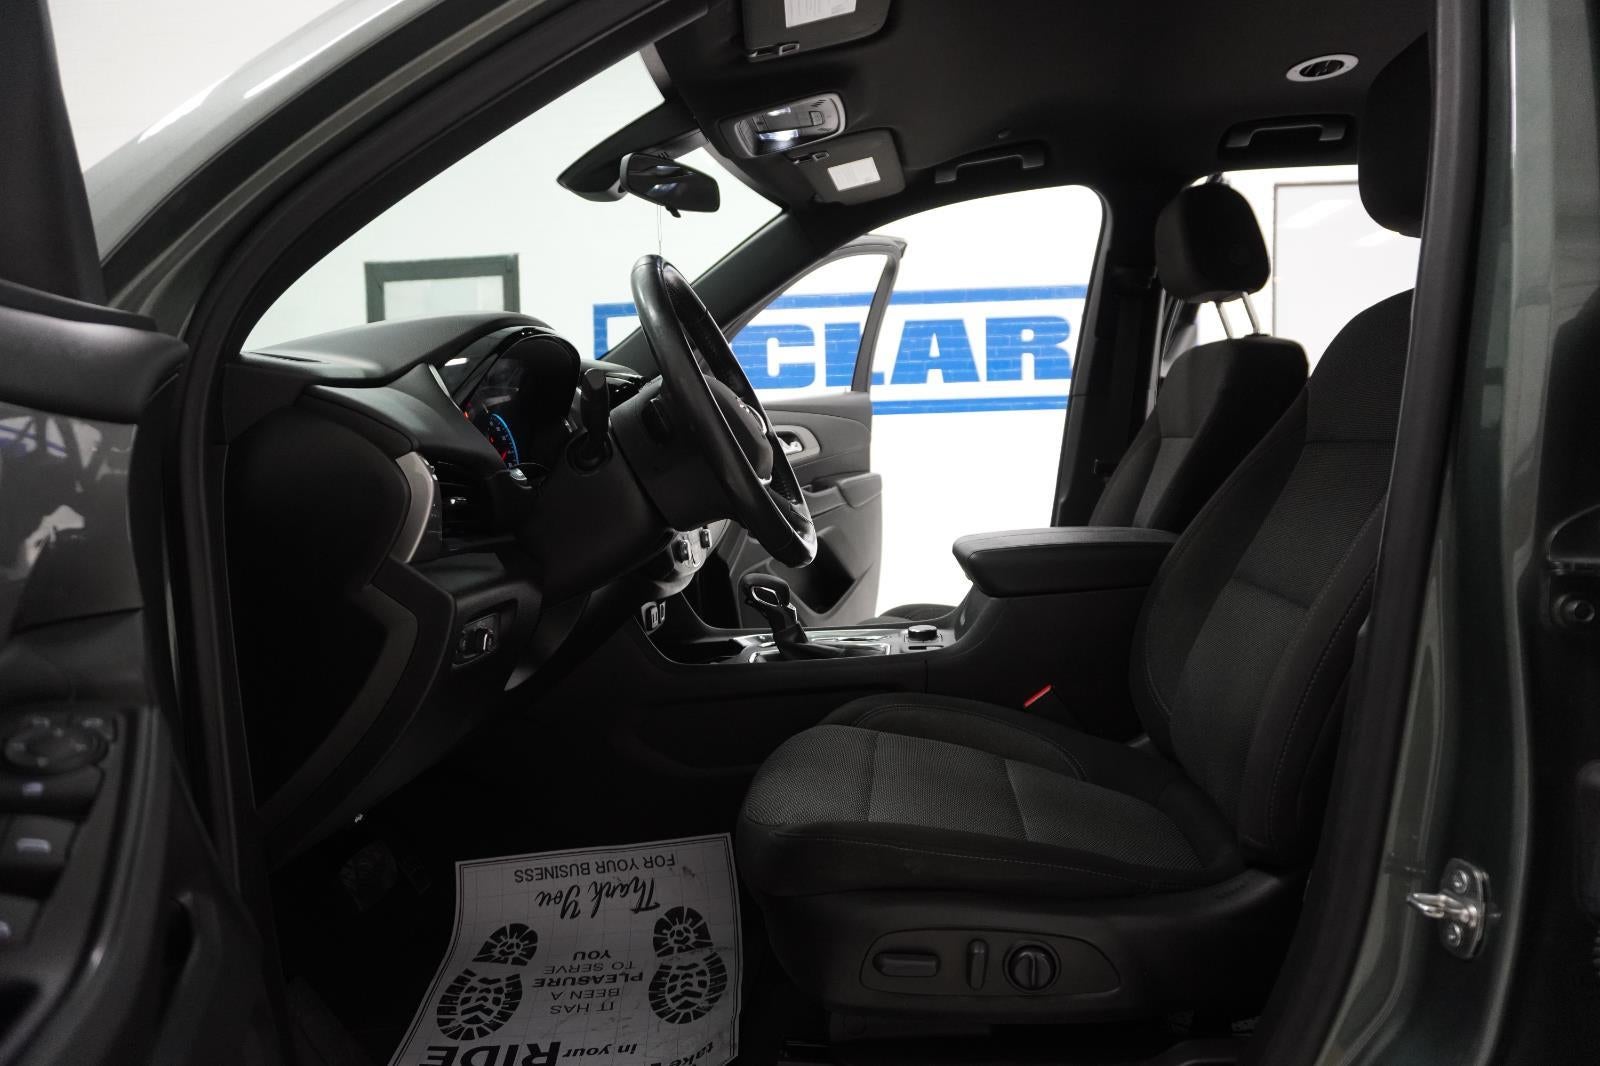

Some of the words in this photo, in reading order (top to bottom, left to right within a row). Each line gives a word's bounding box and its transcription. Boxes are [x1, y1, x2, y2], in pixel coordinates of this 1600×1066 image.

[644, 853, 675, 868] FOR
[514, 863, 588, 883] BUSINESS
[594, 860, 638, 875] YOUR
[534, 886, 580, 919] You
[587, 876, 661, 919] Thank
[573, 951, 612, 961] YOU
[543, 965, 604, 975] SERVE
[611, 962, 635, 973] TO
[532, 973, 644, 988] PLEASURE
[551, 993, 564, 1002] A
[570, 989, 621, 1000] BEEN
[549, 1004, 590, 1016] HAS
[597, 1003, 614, 1012] IT
[562, 1045, 610, 1057] your
[619, 1043, 637, 1055] in
